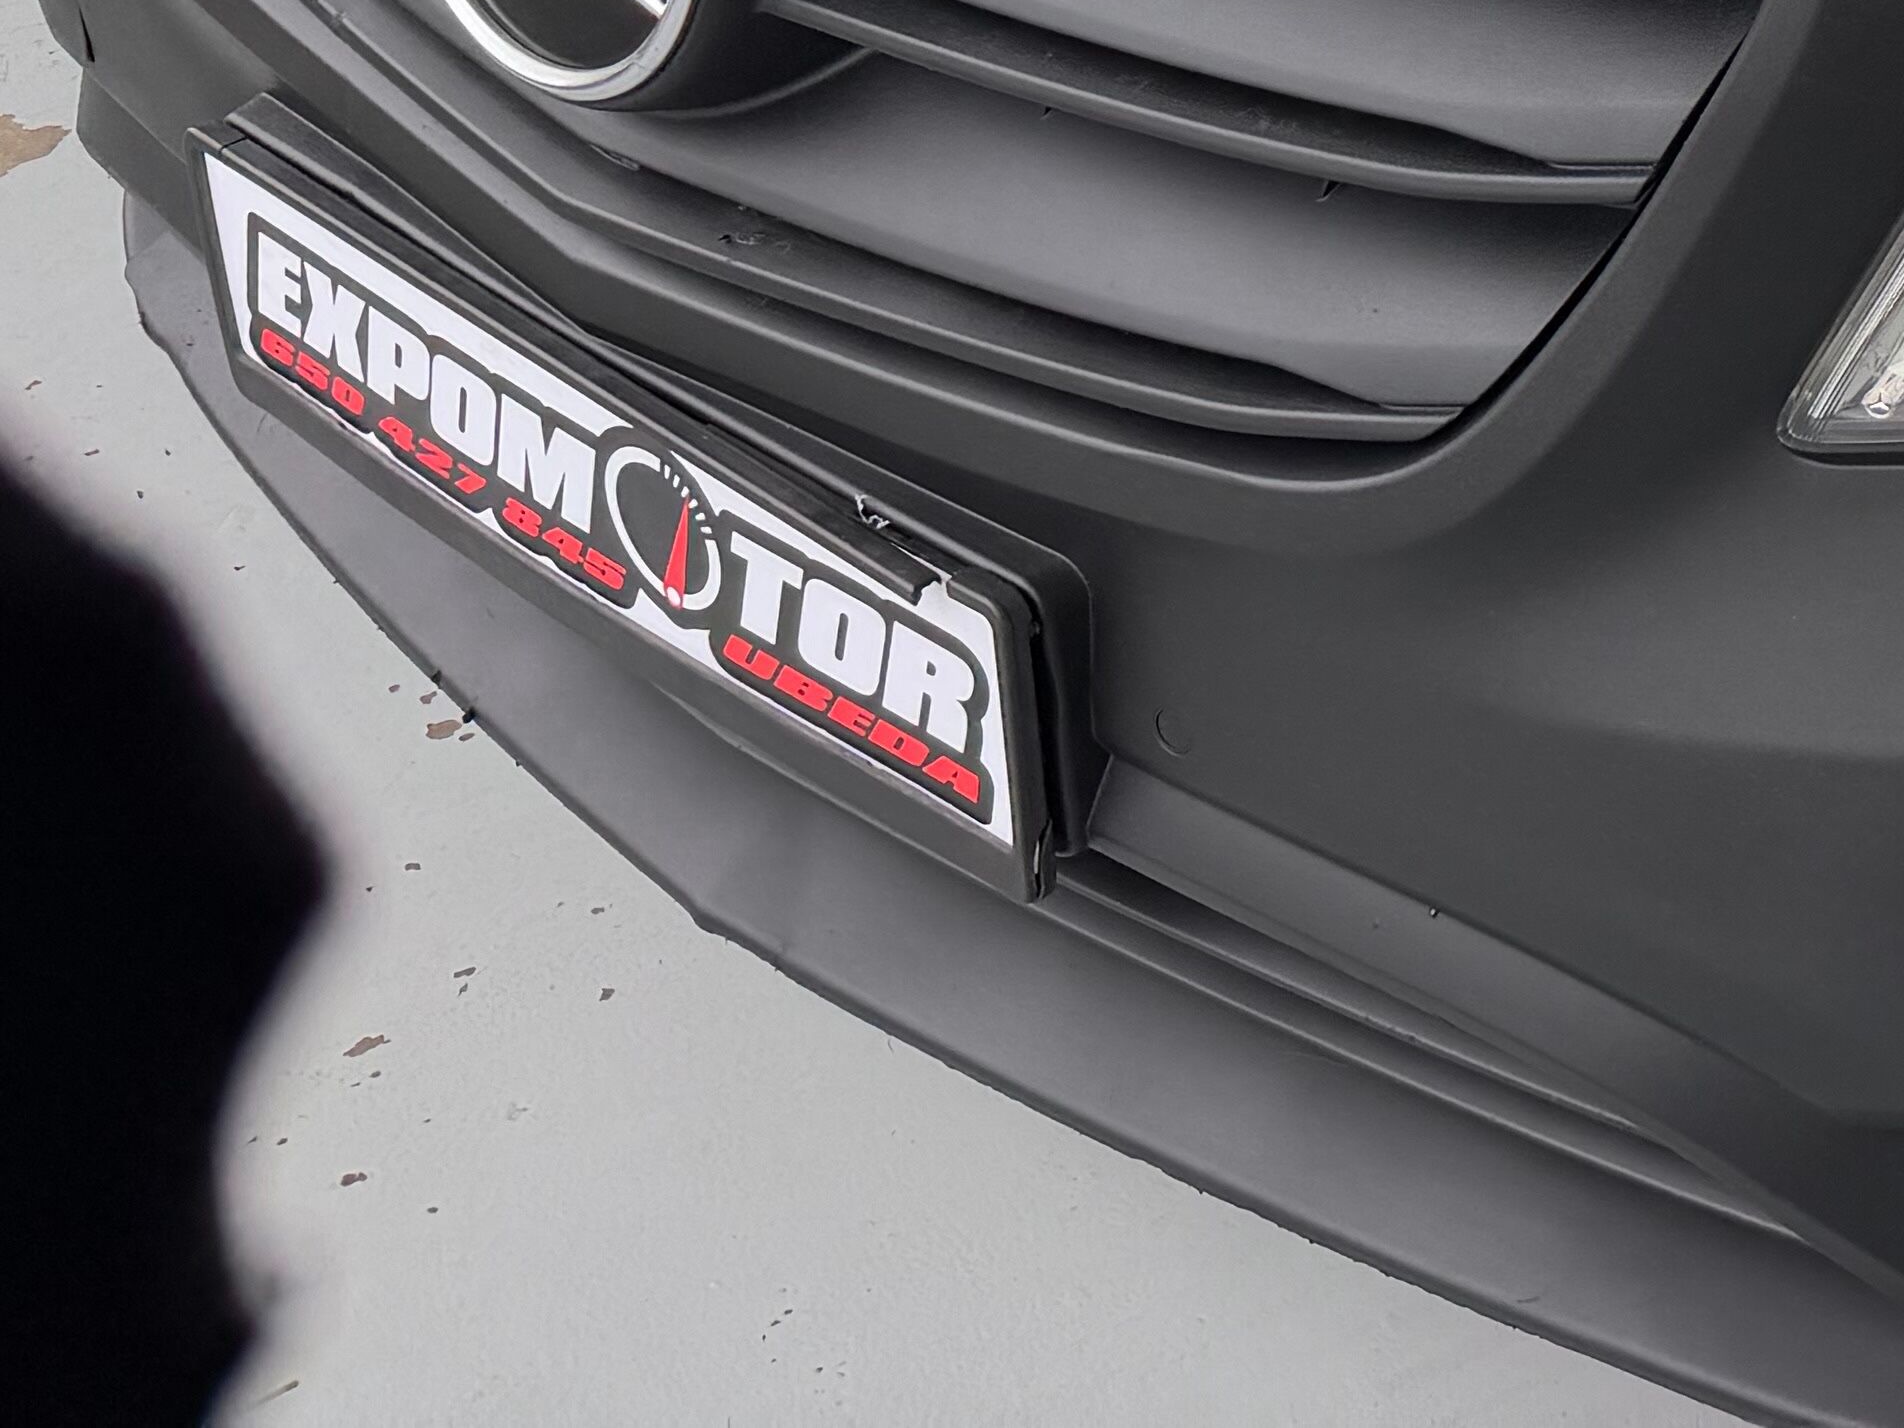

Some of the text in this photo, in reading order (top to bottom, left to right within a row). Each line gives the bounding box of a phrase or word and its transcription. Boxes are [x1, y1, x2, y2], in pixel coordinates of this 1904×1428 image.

[259, 327, 627, 591] 650 427 845
[722, 634, 981, 805] UBEDA
